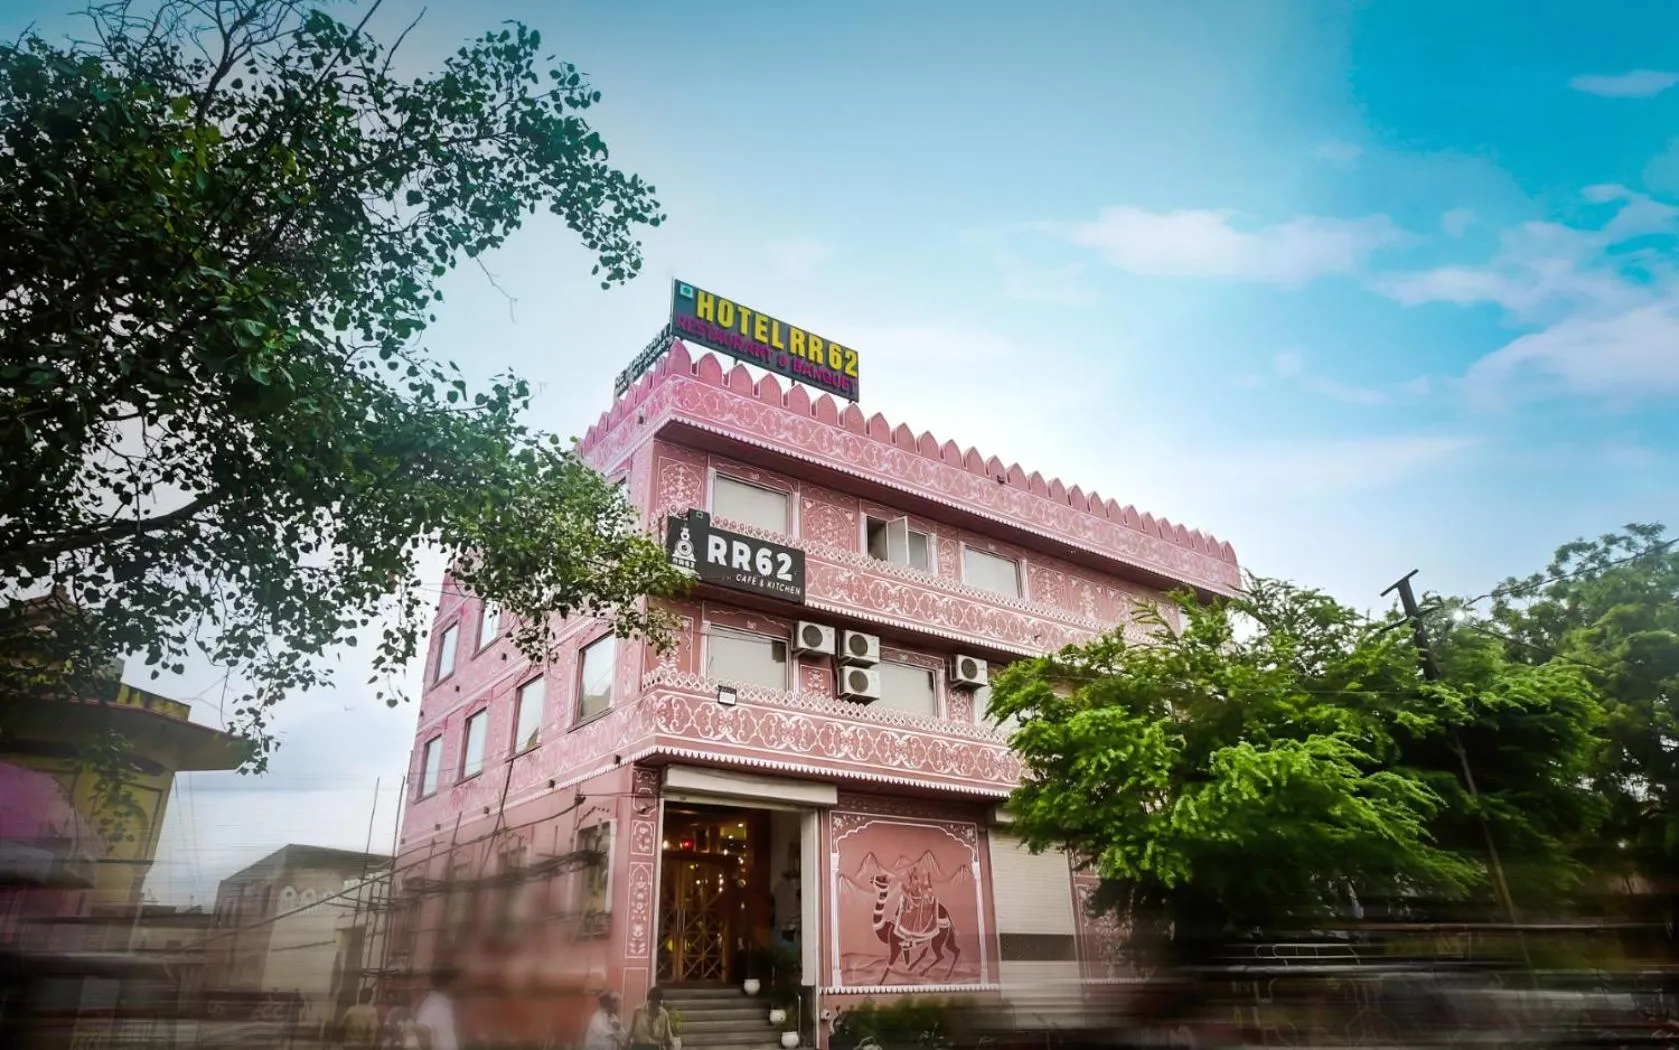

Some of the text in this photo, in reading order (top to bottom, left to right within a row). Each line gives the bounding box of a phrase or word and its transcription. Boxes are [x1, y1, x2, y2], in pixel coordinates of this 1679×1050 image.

[696, 290, 784, 349] HOTEL
[678, 315, 774, 363] RESTAURANT
[793, 358, 857, 393] BANQUET
[707, 534, 792, 582] RR62
[736, 574, 800, 595] CAFE & KITCHEN
